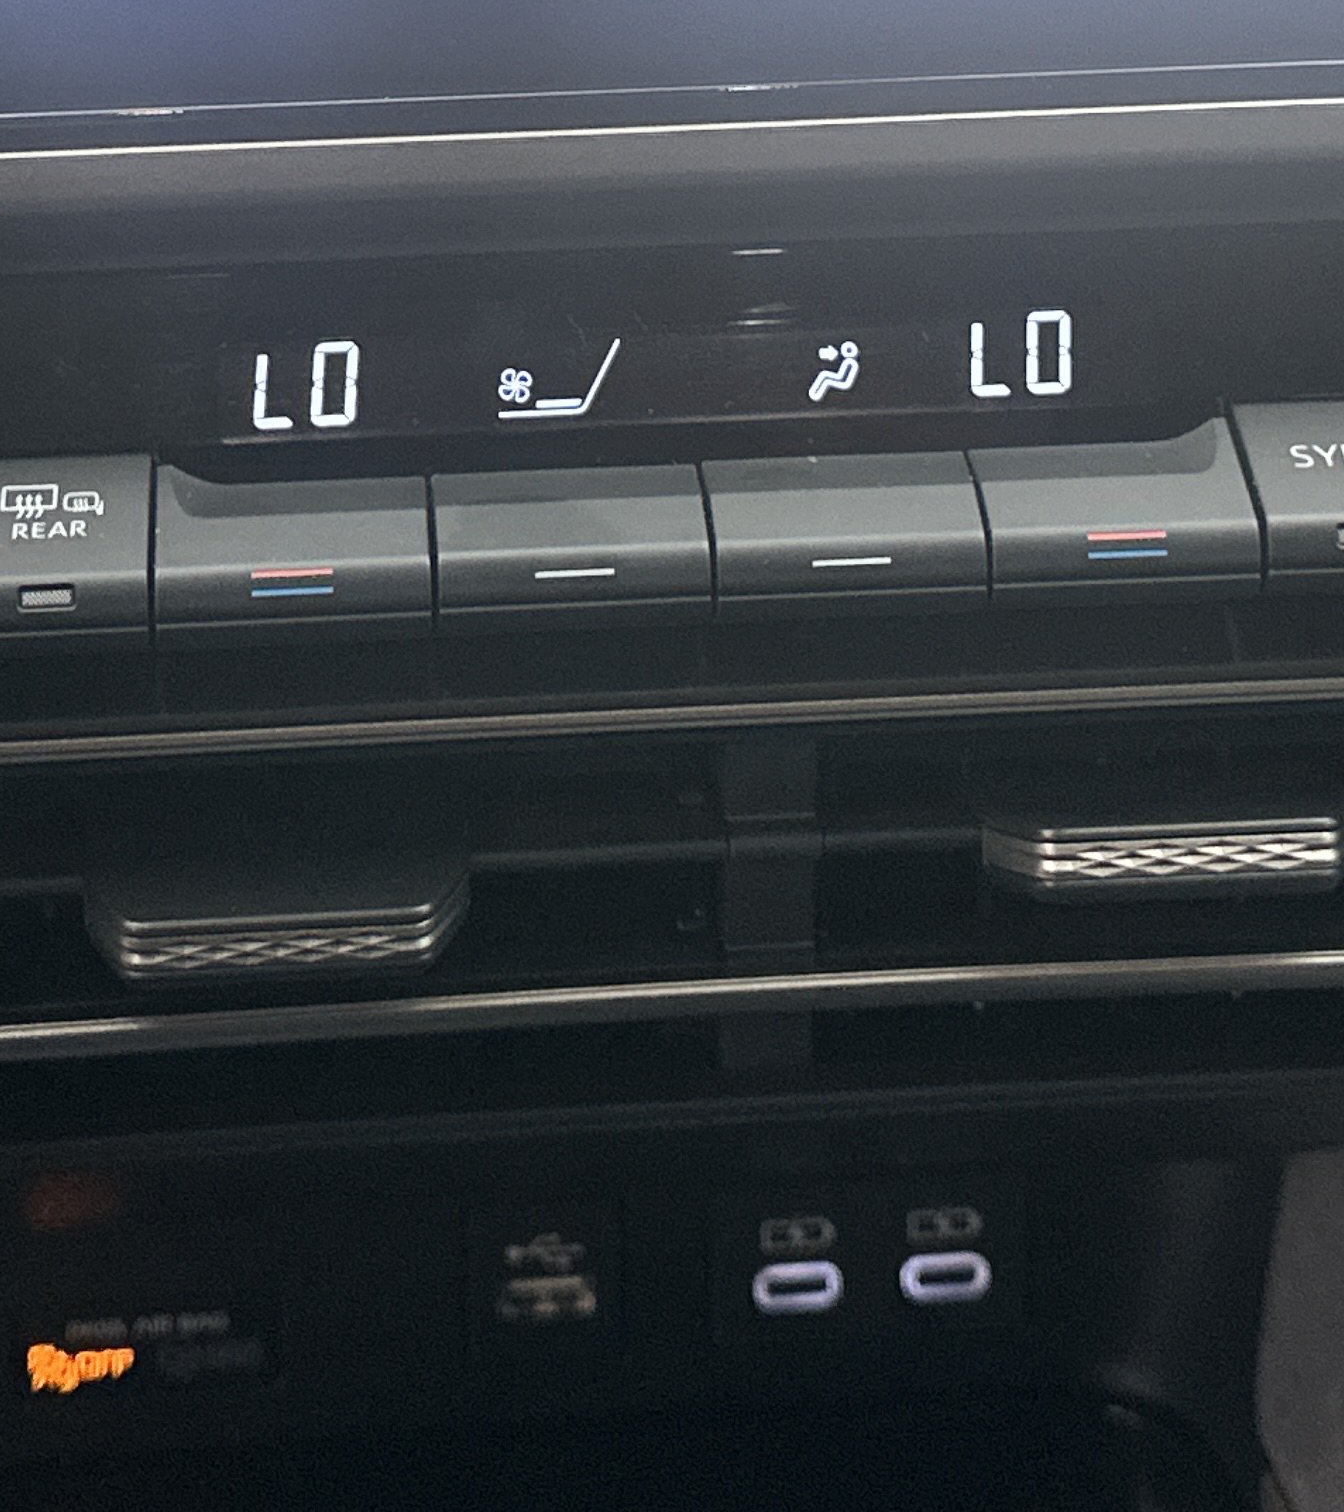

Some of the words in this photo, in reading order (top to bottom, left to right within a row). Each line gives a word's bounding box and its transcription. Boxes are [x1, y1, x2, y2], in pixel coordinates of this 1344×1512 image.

[253, 341, 359, 430] LO
[971, 310, 1071, 397] LO
[12, 518, 87, 539] REAR
